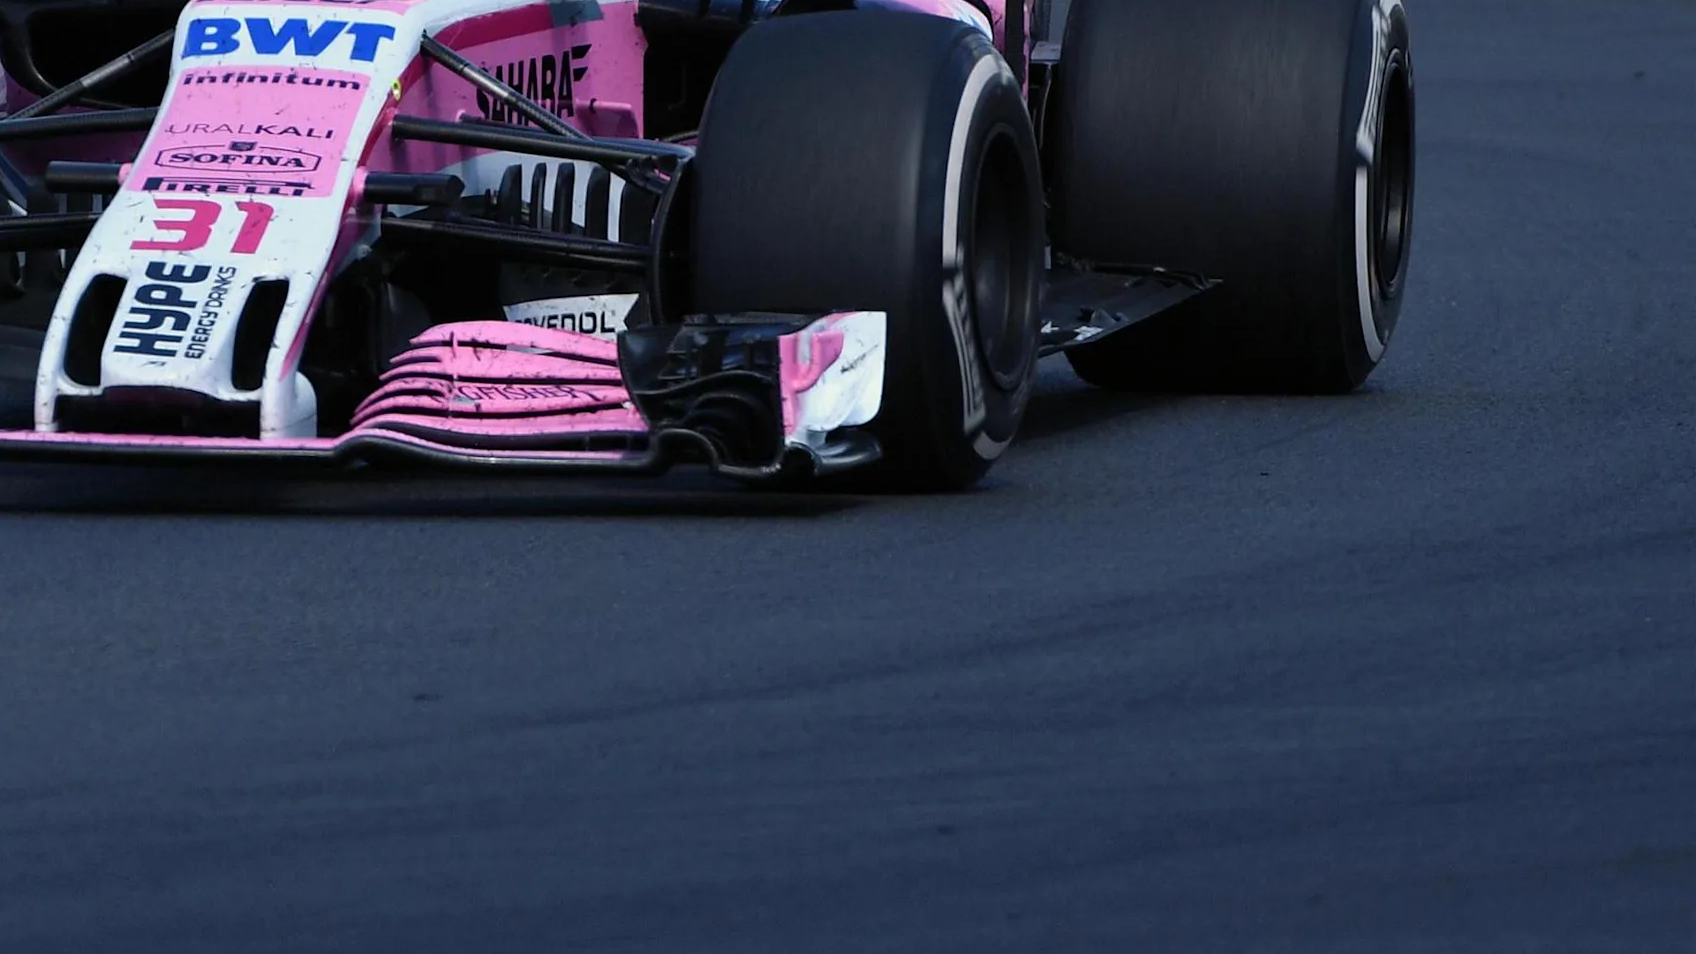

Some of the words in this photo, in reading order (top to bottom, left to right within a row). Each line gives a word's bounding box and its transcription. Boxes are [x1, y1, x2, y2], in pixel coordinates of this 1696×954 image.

[181, 16, 396, 63] BWT
[182, 72, 361, 91] infinitum
[165, 123, 334, 140] URALKALI
[169, 153, 306, 168] SOFINA
[142, 177, 315, 197] PIRELLI
[129, 200, 275, 254] 31
[112, 261, 212, 358] HYPE
[184, 310, 219, 360] ENERGY
[207, 266, 237, 309] DRINKS
[516, 311, 616, 334] VENOL
